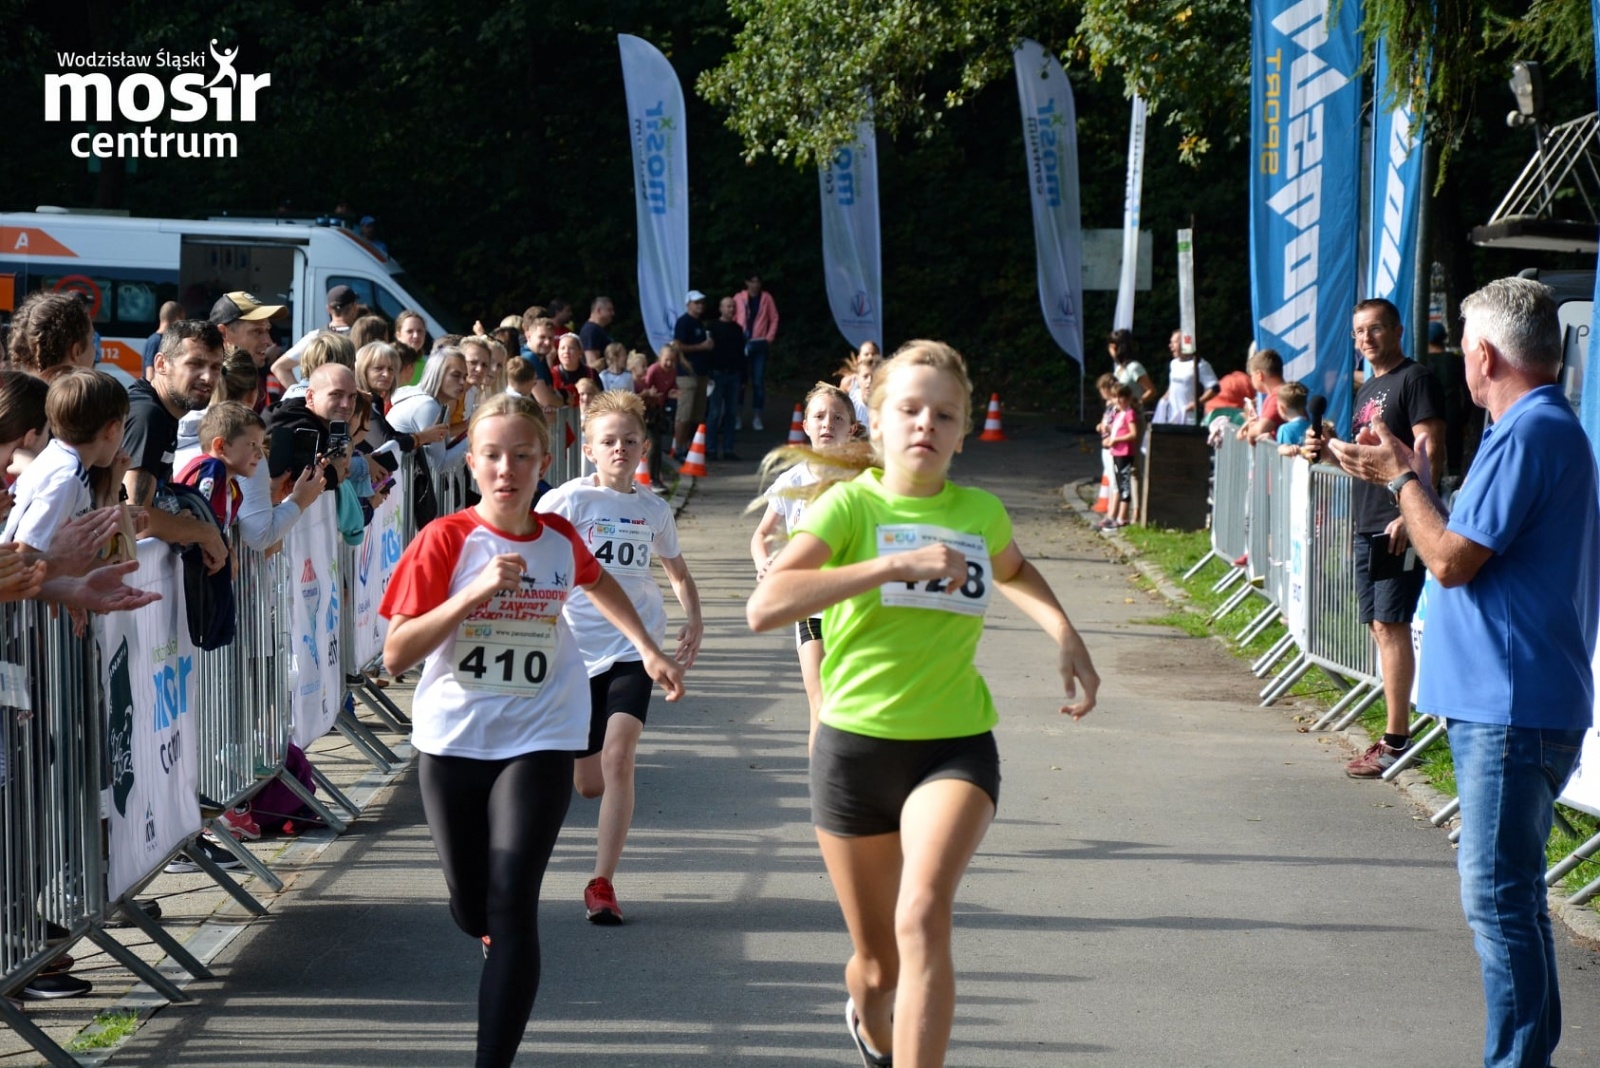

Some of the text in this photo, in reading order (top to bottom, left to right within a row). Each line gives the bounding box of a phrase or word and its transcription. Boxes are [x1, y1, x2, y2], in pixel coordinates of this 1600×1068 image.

[14, 232, 29, 250] A
[594, 540, 649, 567] 403
[458, 646, 548, 684] 410
